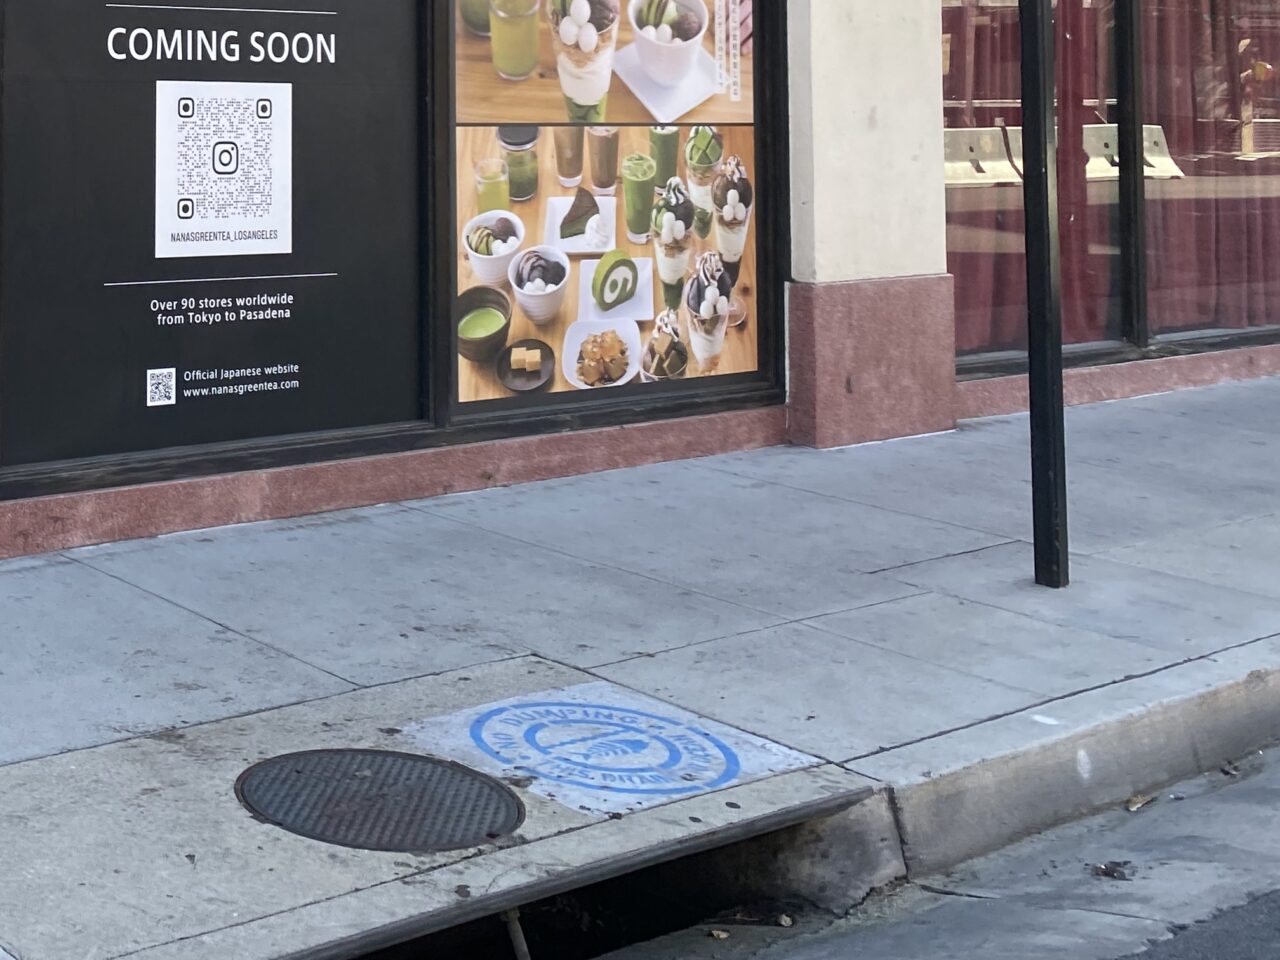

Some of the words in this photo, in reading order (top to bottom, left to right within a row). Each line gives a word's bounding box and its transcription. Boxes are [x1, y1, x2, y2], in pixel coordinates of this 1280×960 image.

[107, 27, 240, 62] COMING
[249, 31, 336, 64] SOON
[170, 229, 278, 243] NANASGREENTEA_LOSANGELES
[150, 299, 178, 311] Over
[181, 298, 196, 310] 90
[198, 297, 233, 308] stores
[236, 293, 294, 306] worldwide
[157, 314, 184, 325] from
[188, 311, 221, 325] Tokyo
[225, 311, 236, 321] to
[239, 308, 291, 320] Pasadena
[184, 369, 218, 381] Official
[221, 366, 261, 380] Japanese
[264, 364, 299, 375] website
[184, 380, 300, 397] www.nanasgreentea.com
[498, 708, 639, 727] DUMPING
[491, 731, 521, 750] NO
[537, 759, 592, 778] THIS
